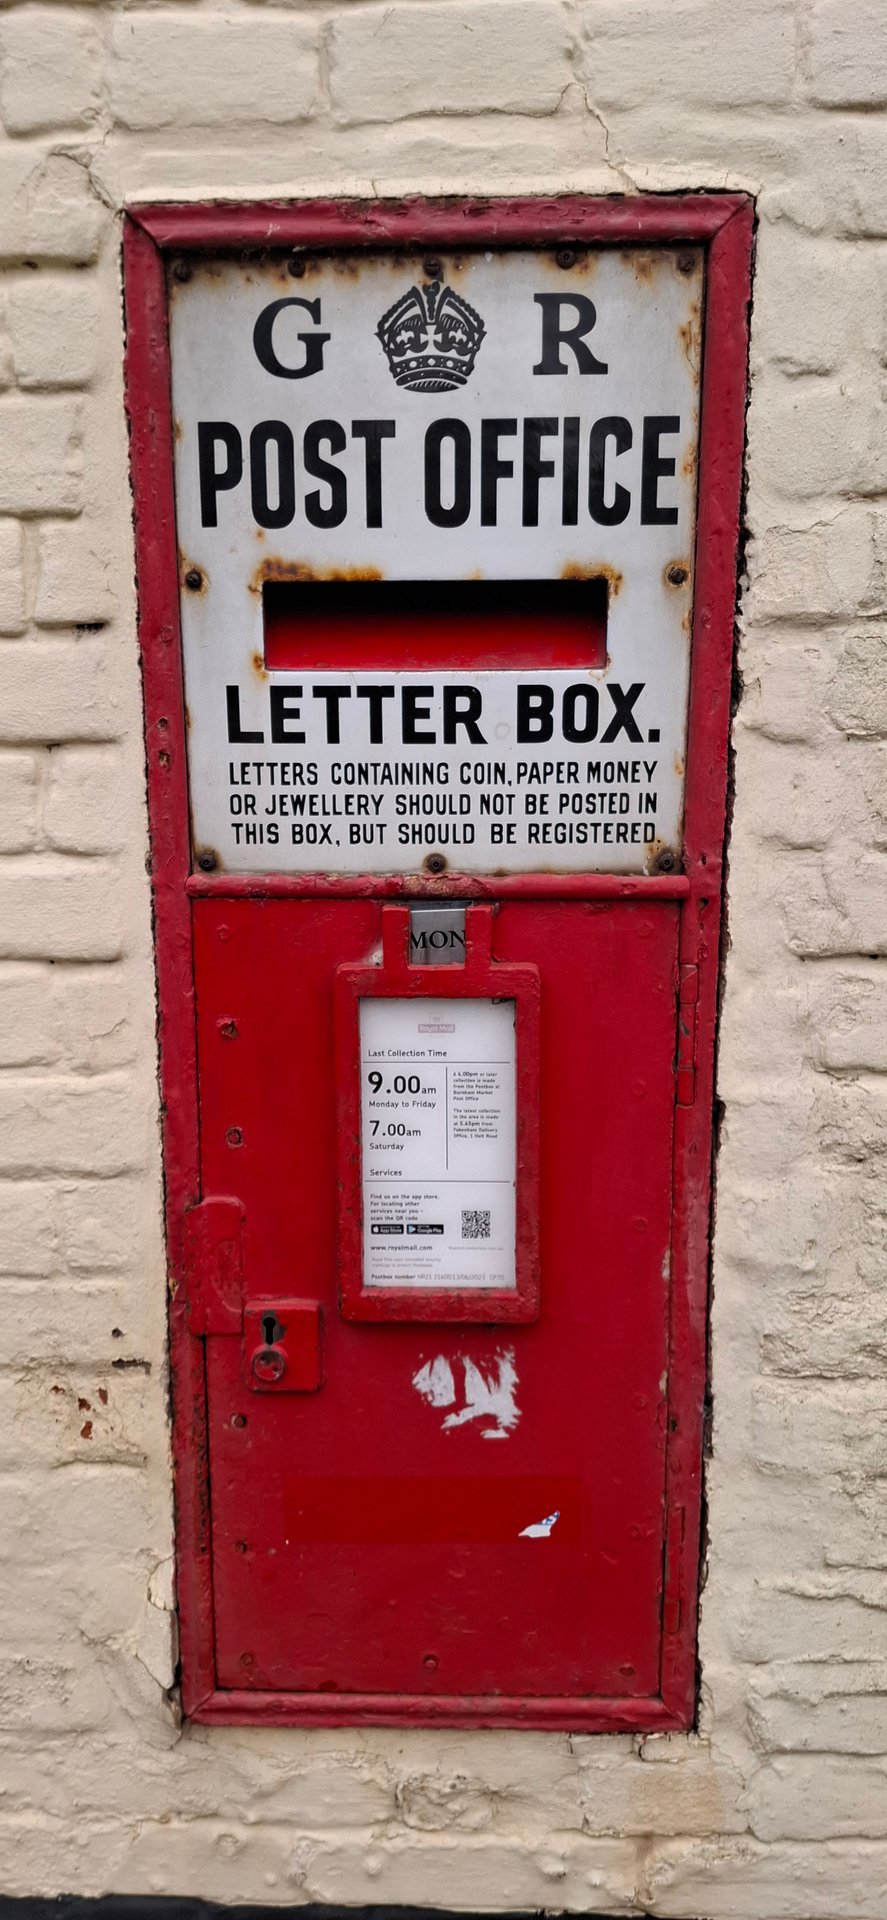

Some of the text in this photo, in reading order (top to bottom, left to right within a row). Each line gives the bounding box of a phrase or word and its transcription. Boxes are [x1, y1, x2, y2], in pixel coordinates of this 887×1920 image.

[253, 293, 608, 379] G R
[198, 416, 681, 529] POST OFFICE
[226, 684, 660, 745] LETTER BOX.
[229, 761, 658, 786] LETTERS CONTAINING COIN, PAPER MONEY
[230, 792, 657, 816] OR JEWELLERY SHOULD NOT BE POSTED IN
[231, 823, 279, 844] THIS
[292, 823, 340, 846] BOX,
[349, 823, 387, 844] BUT
[398, 823, 475, 844] SHOULD
[490, 823, 517, 844] BE
[409, 930, 466, 949] MON
[368, 1049, 385, 1057] Last
[388, 1049, 425, 1057] Collection
[368, 1071, 436, 1094] 9.00am
[369, 1101, 399, 1109] Monday
[412, 1101, 436, 1109] Friday
[369, 1120, 421, 1136] 7.00am
[369, 1143, 405, 1151] Saturday
